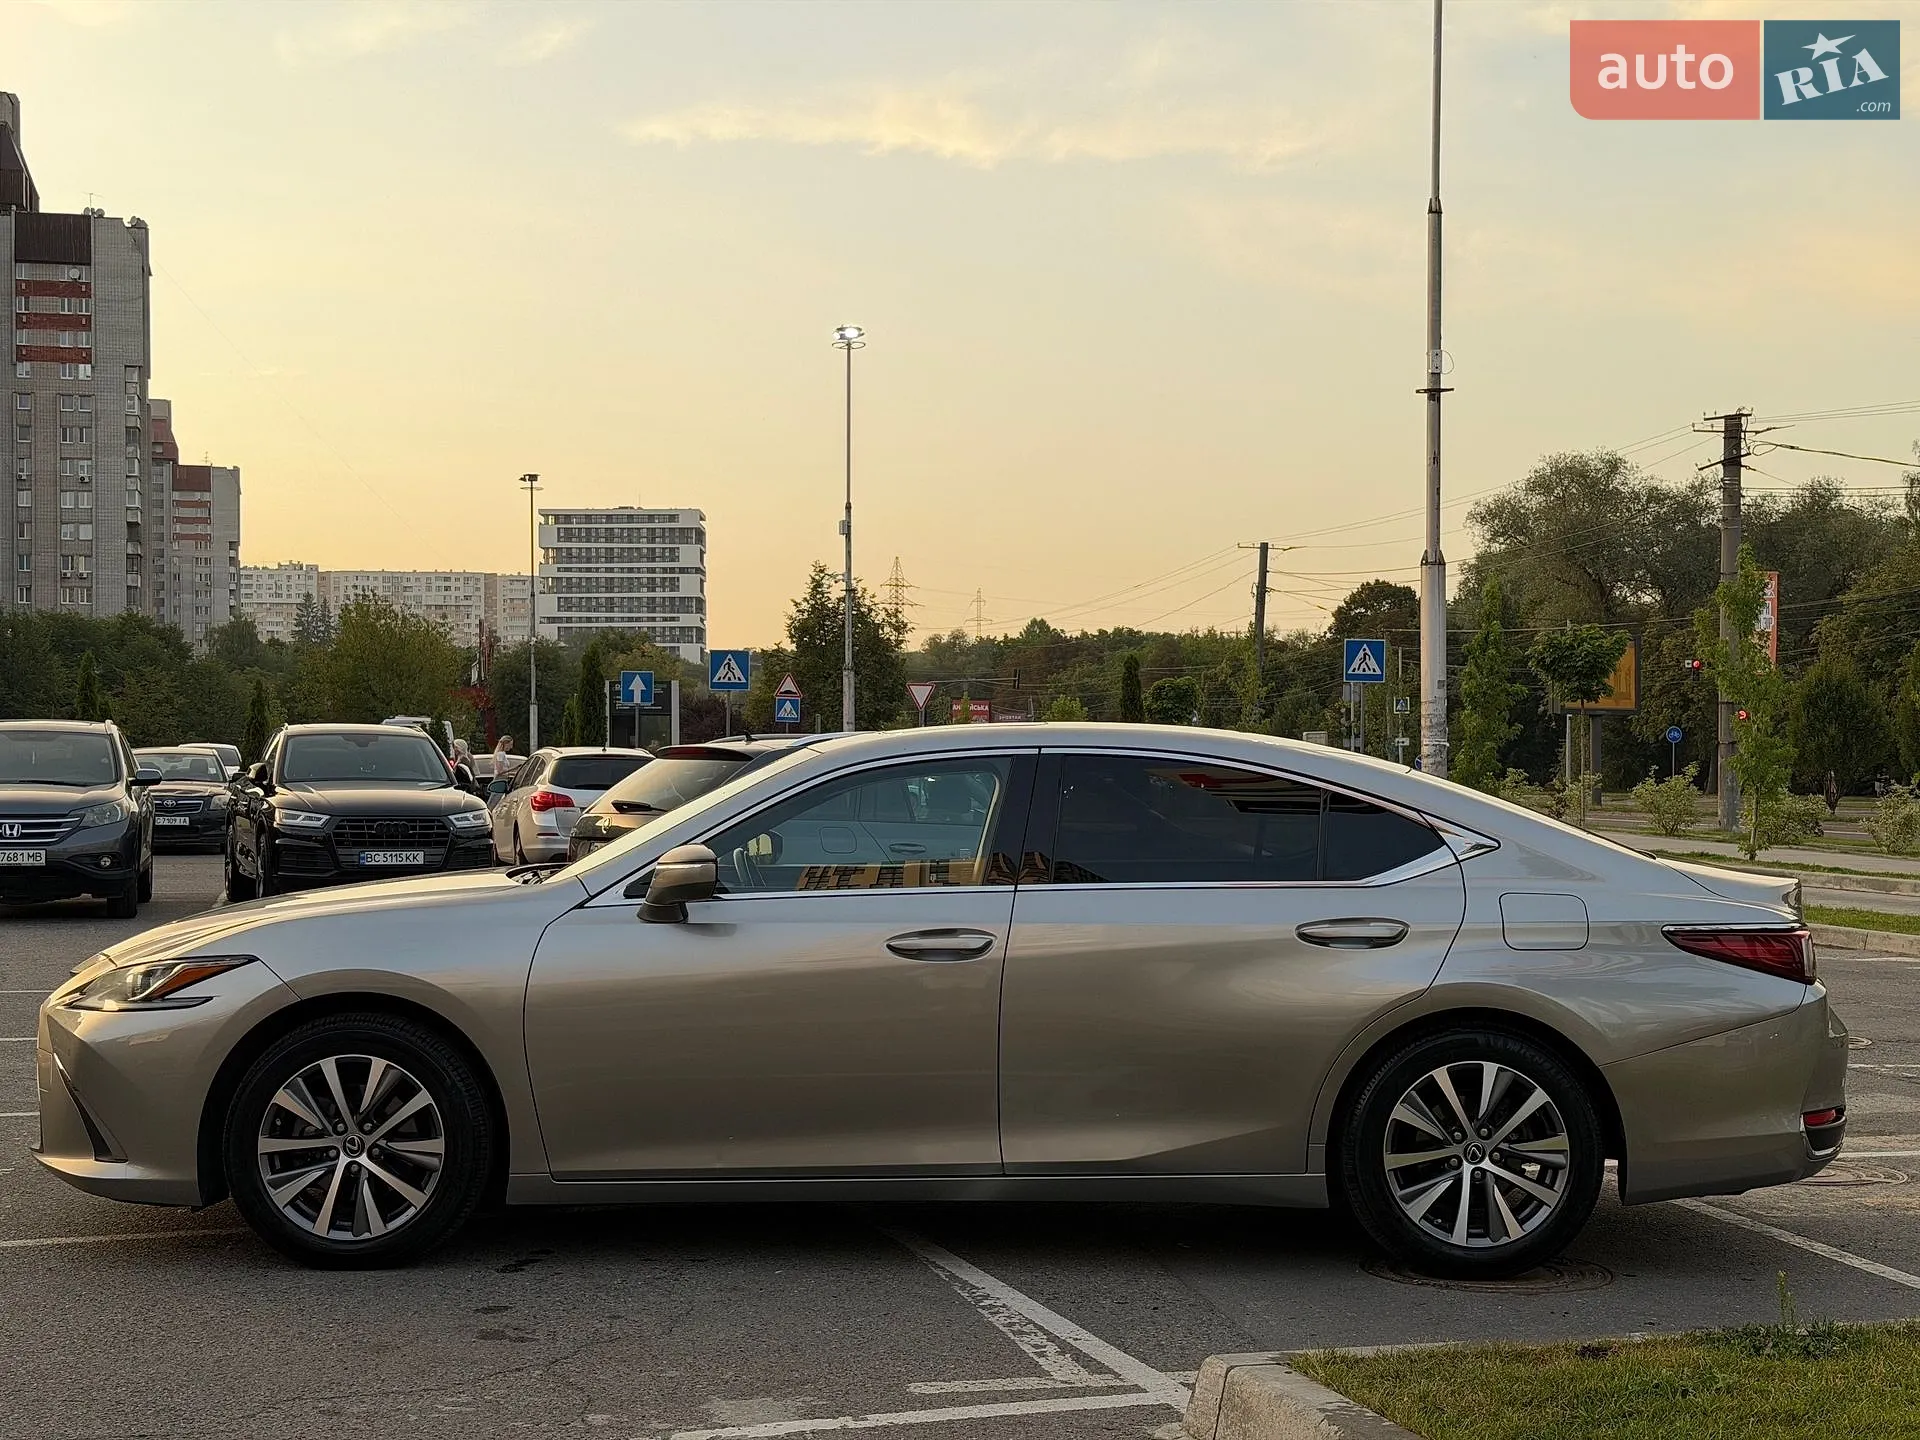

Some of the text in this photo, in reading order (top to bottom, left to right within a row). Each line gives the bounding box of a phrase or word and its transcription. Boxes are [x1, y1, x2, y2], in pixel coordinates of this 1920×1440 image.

[0, 852, 43, 862] 7681 MB
[366, 853, 381, 863] BC
[382, 853, 404, 863] 5115
[405, 853, 420, 863] KK
